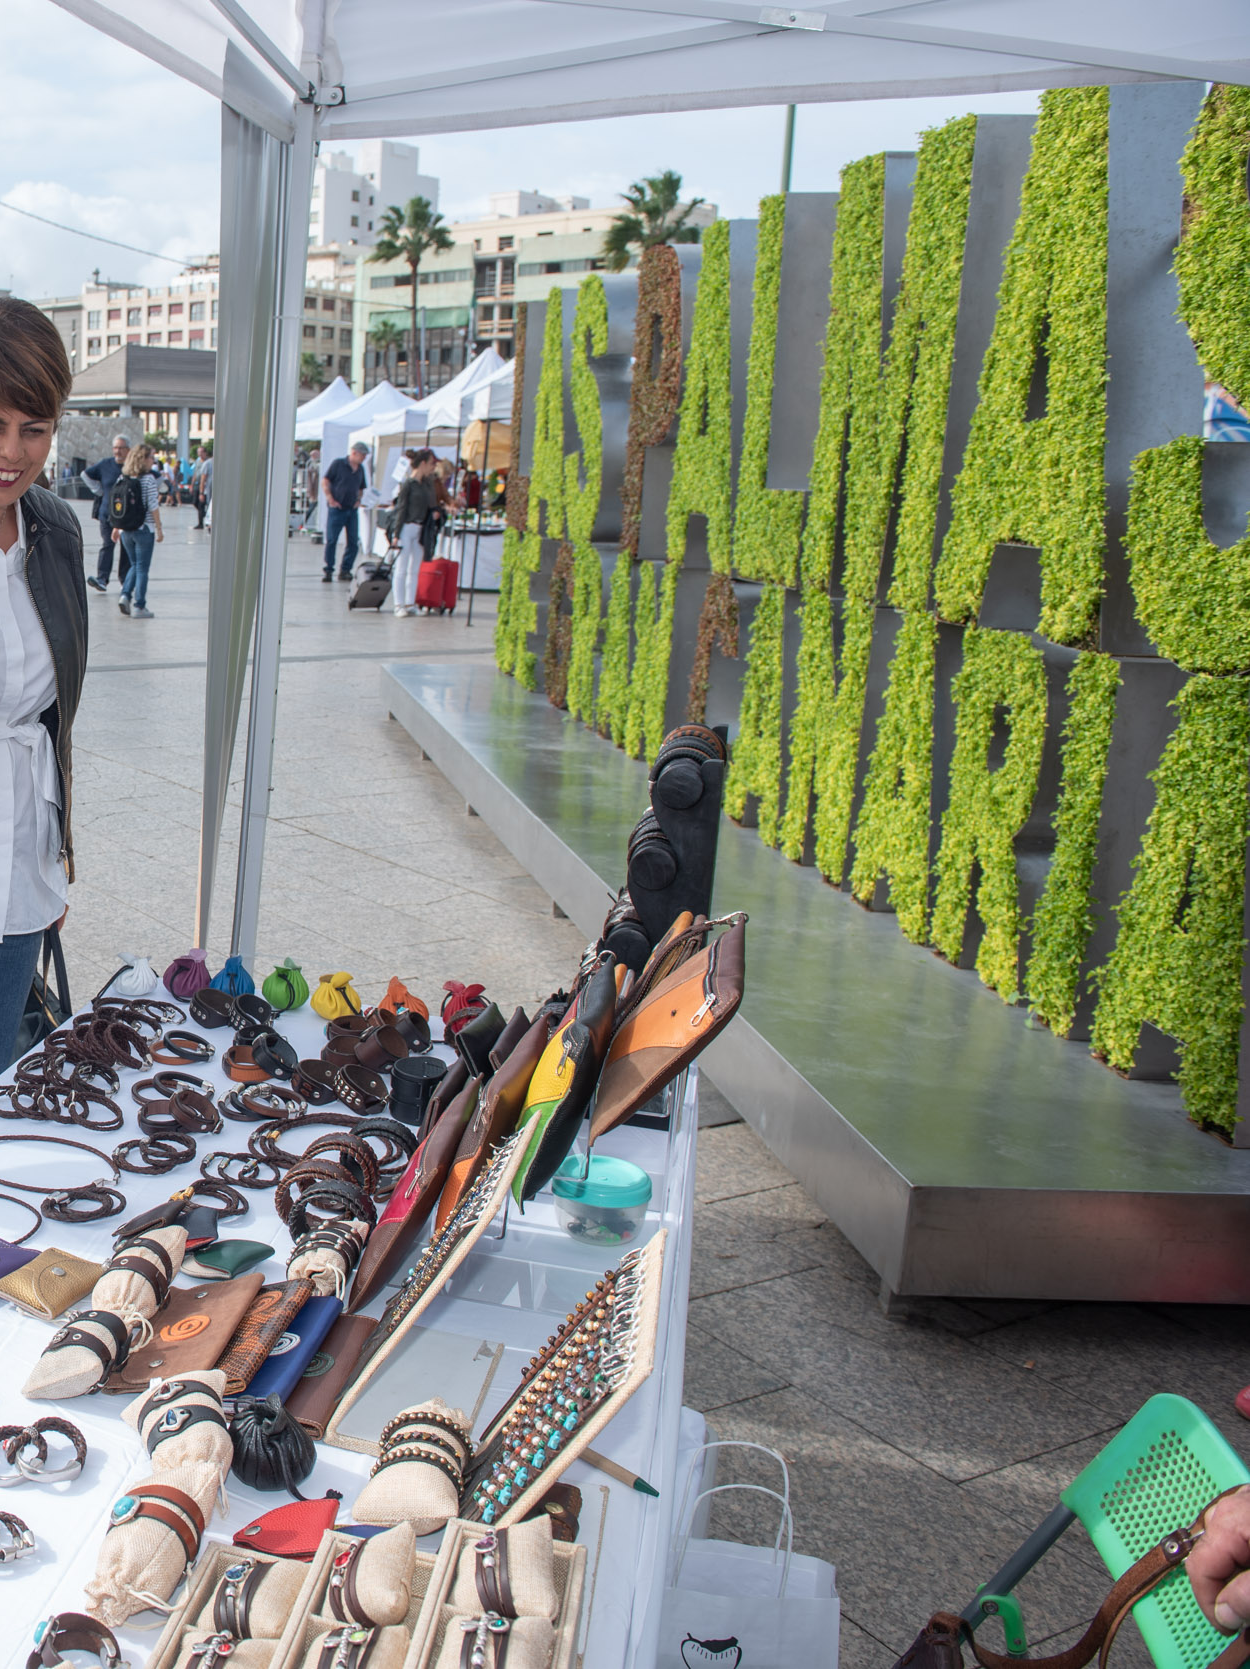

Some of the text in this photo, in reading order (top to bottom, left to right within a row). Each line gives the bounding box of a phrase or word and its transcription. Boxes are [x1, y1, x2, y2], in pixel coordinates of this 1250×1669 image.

[505, 274, 608, 542] LAS
[543, 540, 678, 766] GRAN
[687, 574, 1250, 1140] CANARIA
